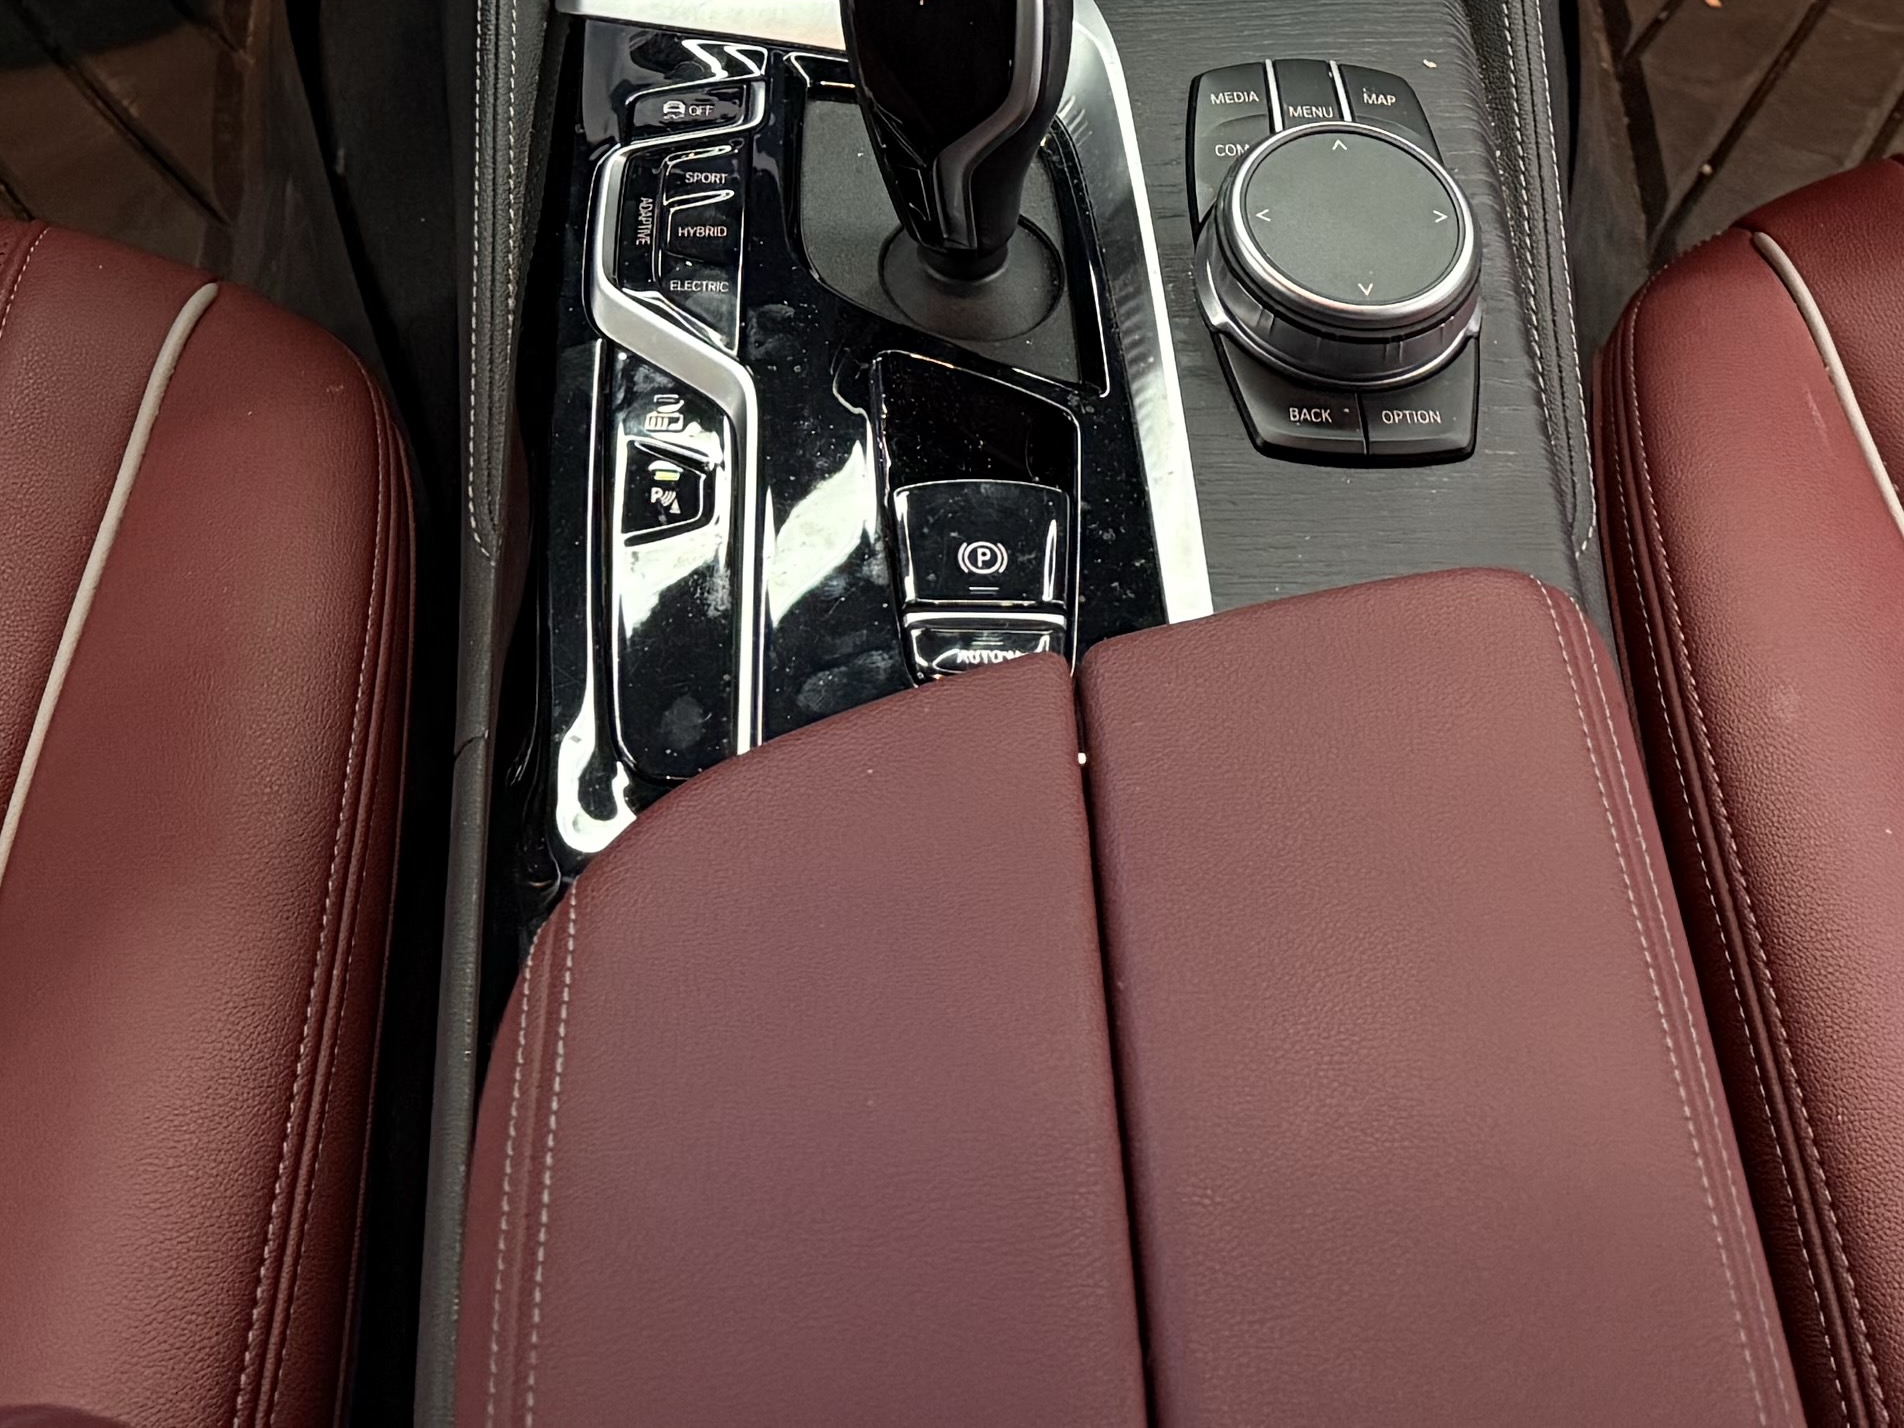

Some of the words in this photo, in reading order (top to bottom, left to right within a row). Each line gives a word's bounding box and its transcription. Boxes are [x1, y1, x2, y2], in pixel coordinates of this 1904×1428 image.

[1210, 91, 1259, 105] MEDIA
[1363, 92, 1396, 106] MAP
[688, 105, 714, 116] OFF
[1289, 105, 1334, 119] MENU
[685, 172, 728, 184] SPORT
[636, 197, 653, 246] ADAPTIVE
[678, 226, 727, 237] HYBRID
[670, 280, 729, 293] ELECTRIC
[1289, 407, 1332, 423] BACK
[1381, 410, 1442, 424] OPTION
